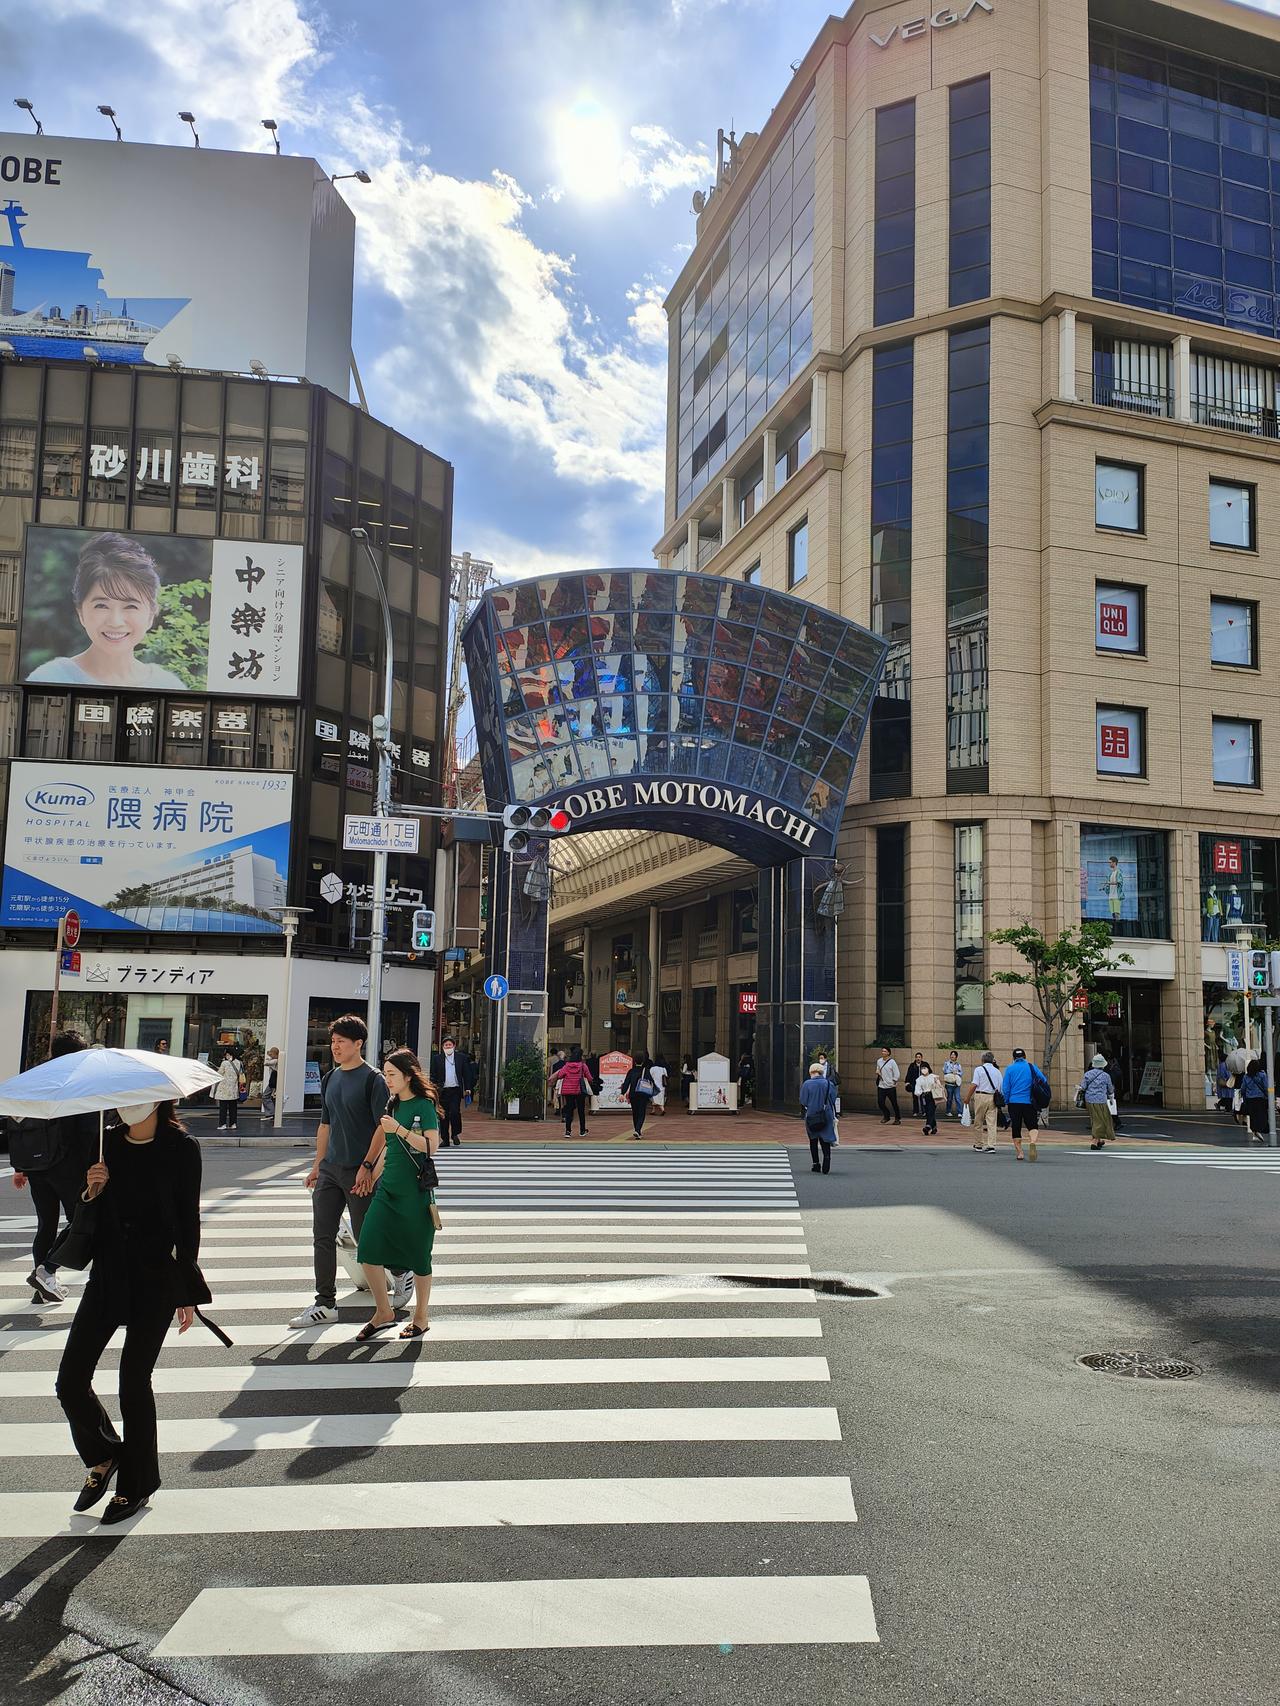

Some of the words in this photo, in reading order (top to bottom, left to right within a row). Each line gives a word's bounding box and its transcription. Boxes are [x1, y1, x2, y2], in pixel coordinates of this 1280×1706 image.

[868, 0, 994, 48] VEGA
[0, 156, 62, 185] OBE
[90, 445, 261, 490] 砂川歯科
[272, 558, 286, 682] シニア向け分譲マンション
[1103, 607, 1123, 620] UNI
[1103, 620, 1125, 633] QLO
[78, 704, 248, 730] 国際楽器
[171, 731, 202, 739] 1911
[108, 785, 152, 796] 医療法人
[262, 779, 288, 791] 1932
[35, 791, 87, 806] Kuma
[107, 797, 234, 834] 隈病院
[633, 781, 818, 847] MOTOMACHI
[25, 818, 92, 828] HOSPITAL
[394, 839, 413, 849] Chome
[117, 965, 215, 985] ブランディア
